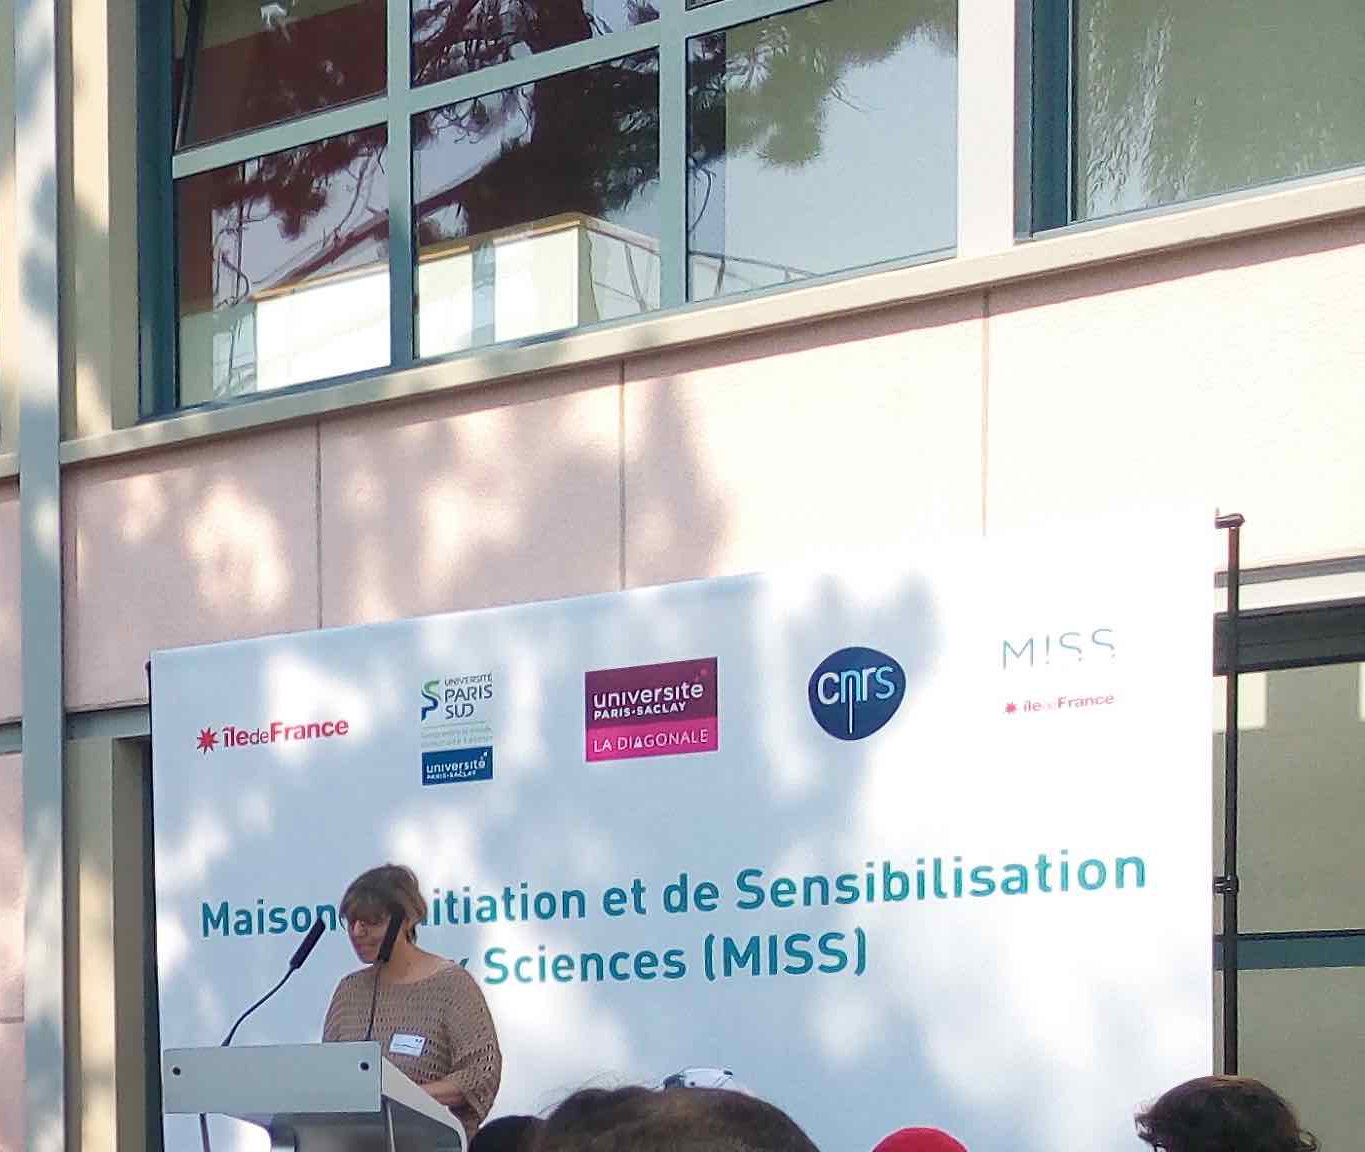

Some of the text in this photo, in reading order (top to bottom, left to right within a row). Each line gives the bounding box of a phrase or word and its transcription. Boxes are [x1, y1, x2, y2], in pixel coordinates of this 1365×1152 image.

[444, 684, 493, 703] PARIS
[445, 702, 474, 719] SUD
[593, 728, 709, 753] LA DIAGONALE
[201, 897, 336, 938] Maison
[601, 877, 648, 917] et
[663, 872, 720, 914] de
[736, 848, 1147, 912] Sensibilisation
[483, 926, 867, 985] Sciences (MISS)
